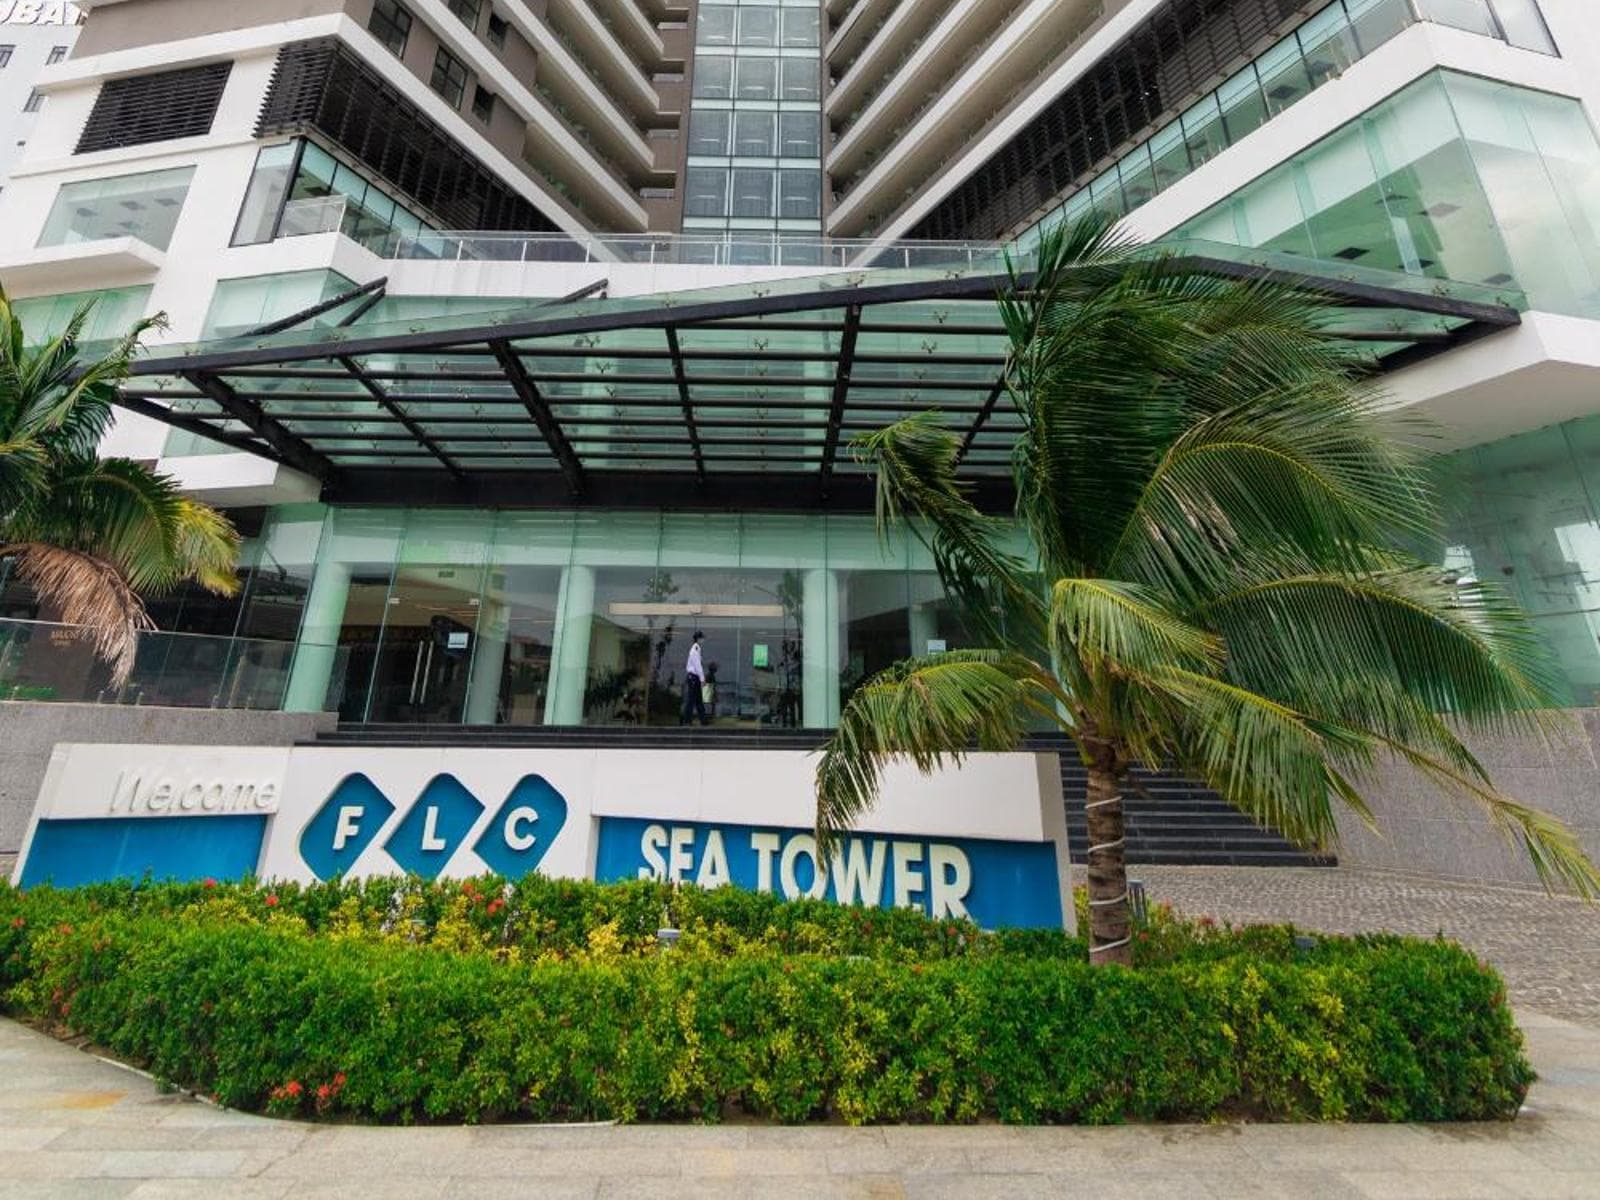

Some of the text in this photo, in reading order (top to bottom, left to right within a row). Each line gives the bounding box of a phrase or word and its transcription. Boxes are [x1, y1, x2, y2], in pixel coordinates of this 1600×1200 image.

[108, 766, 279, 814] Welcome
[638, 824, 731, 890] SEA
[751, 832, 976, 922] TOWER
